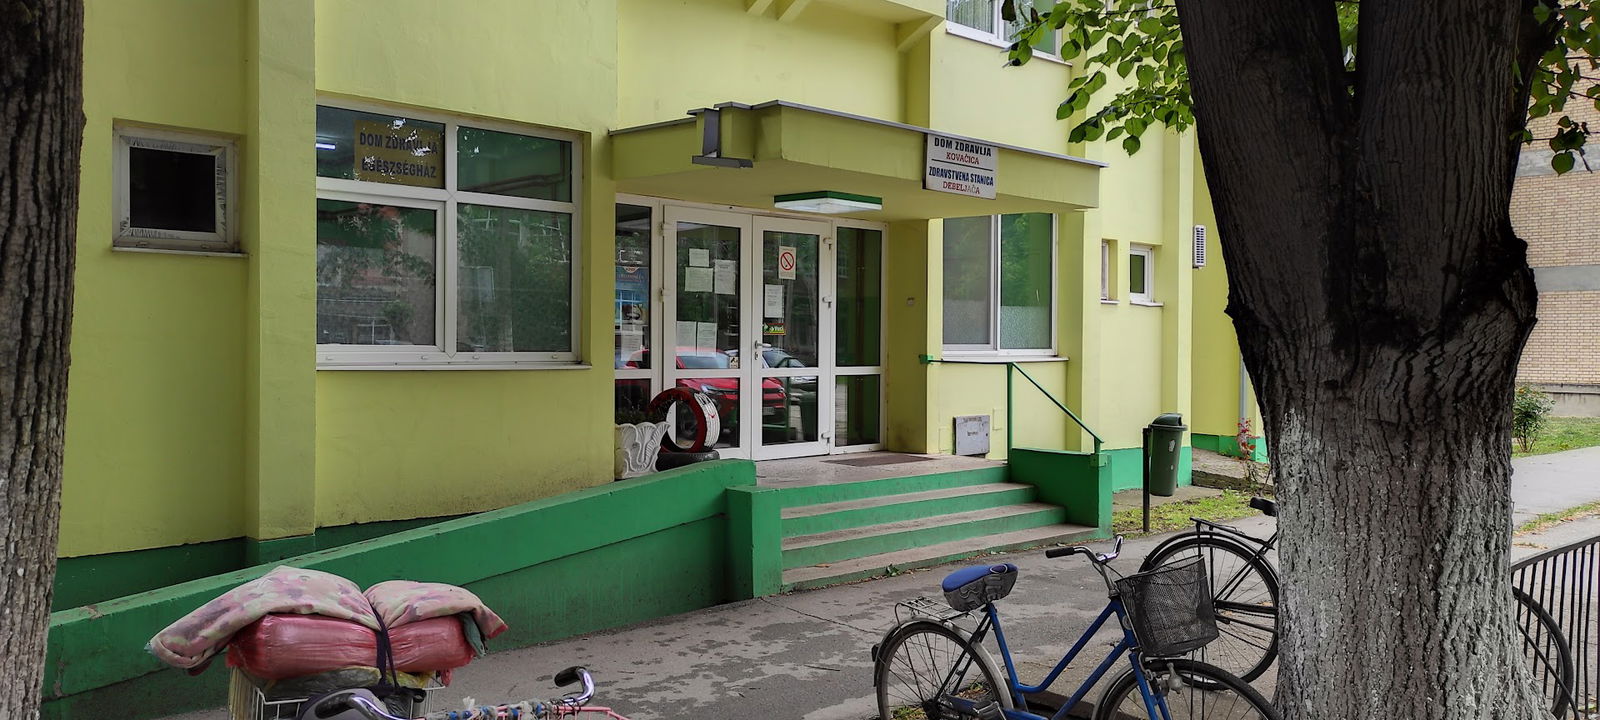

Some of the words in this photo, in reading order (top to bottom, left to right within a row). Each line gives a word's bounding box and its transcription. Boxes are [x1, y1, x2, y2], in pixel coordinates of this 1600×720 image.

[360, 132, 383, 147] DOM
[934, 137, 953, 149] DOM
[955, 141, 992, 157] ZDRAVLJA
[946, 151, 980, 165] KOVAČICA
[928, 166, 970, 182] ZDRAVSTVENA
[970, 173, 994, 187] STANICA
